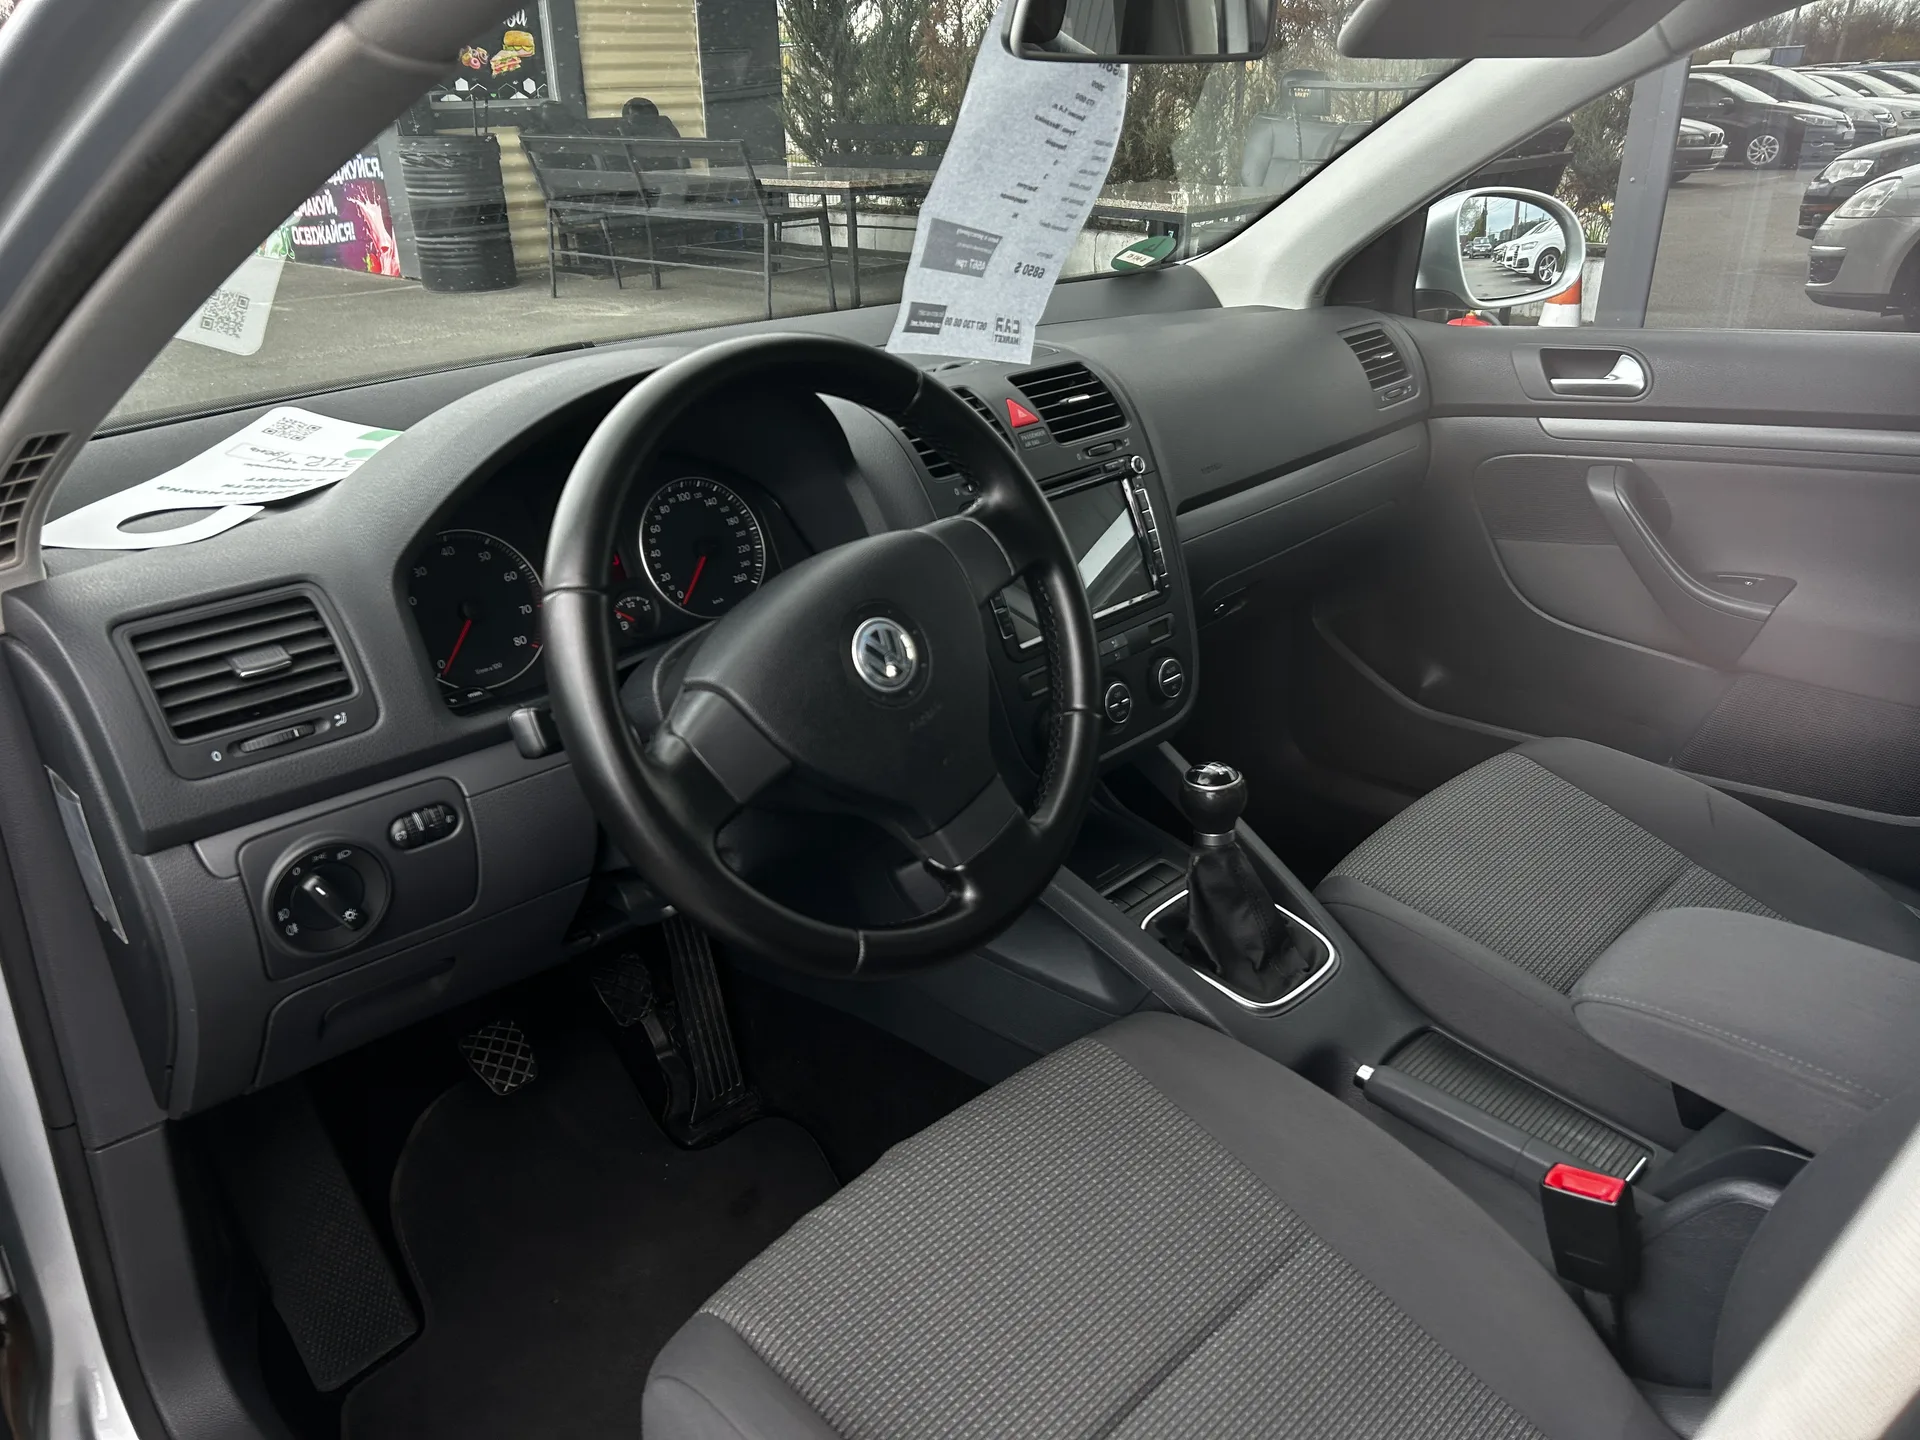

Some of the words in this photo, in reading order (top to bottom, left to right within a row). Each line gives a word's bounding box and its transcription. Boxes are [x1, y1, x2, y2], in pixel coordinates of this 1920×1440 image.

[327, 154, 384, 185] ДЖУЙСЯ,
[291, 219, 356, 246] ОСВІЖАЙСЯ!
[677, 492, 690, 501] 100
[704, 497, 717, 507] 140
[659, 505, 670, 514] 80
[726, 516, 740, 526] 180
[650, 524, 661, 534] 60
[441, 546, 456, 557] 40
[650, 550, 661, 558] 40
[737, 545, 750, 554] 220
[478, 551, 492, 562] 50
[413, 566, 428, 578] 30
[503, 570, 518, 582] 60
[660, 572, 671, 582] 20
[733, 573, 748, 583] 260
[677, 590, 684, 599] 0
[519, 604, 533, 614] 70
[513, 635, 528, 647] 80
[437, 659, 446, 669] 0
[211, 750, 222, 762] 0
